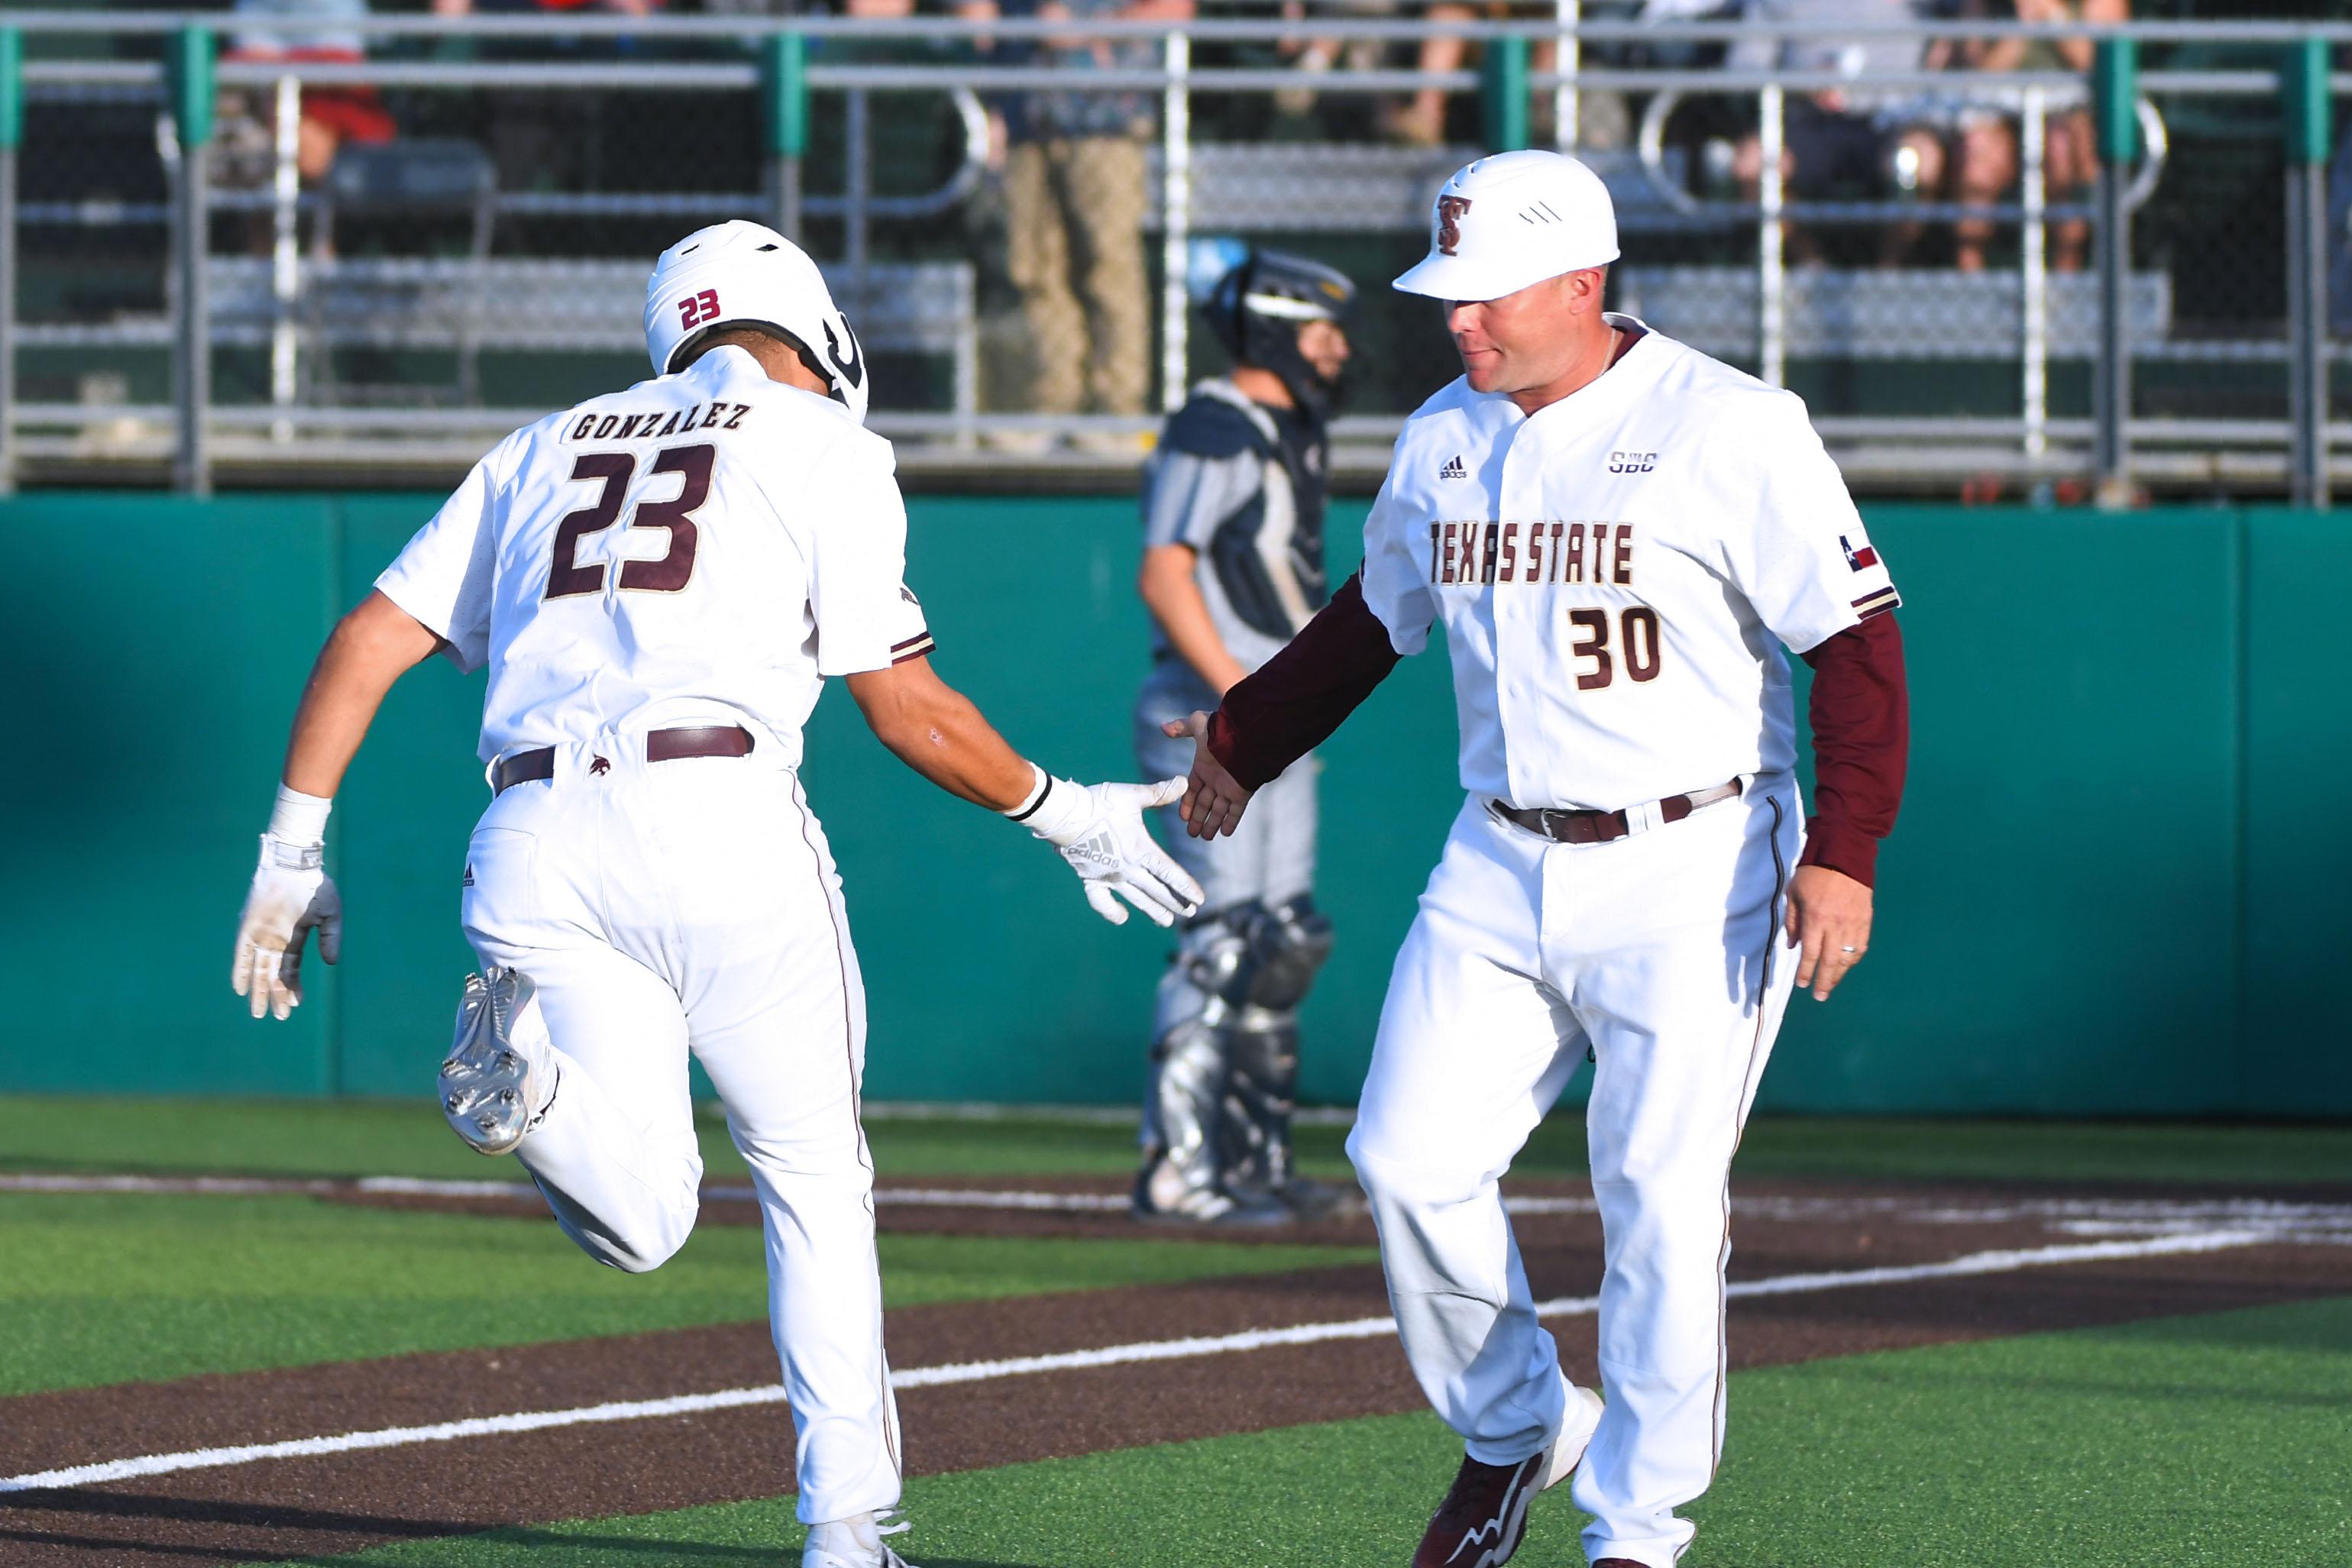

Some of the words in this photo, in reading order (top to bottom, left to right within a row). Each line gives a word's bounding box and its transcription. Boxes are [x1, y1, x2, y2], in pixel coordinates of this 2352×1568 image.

[678, 288, 721, 331] 23
[571, 402, 752, 441] GONZALEZ
[544, 441, 718, 600] 23
[1430, 521, 1520, 585] TEXAS
[1525, 521, 1635, 587] STATE
[1568, 606, 1661, 692] 30
[1067, 847, 1120, 868] adidas
